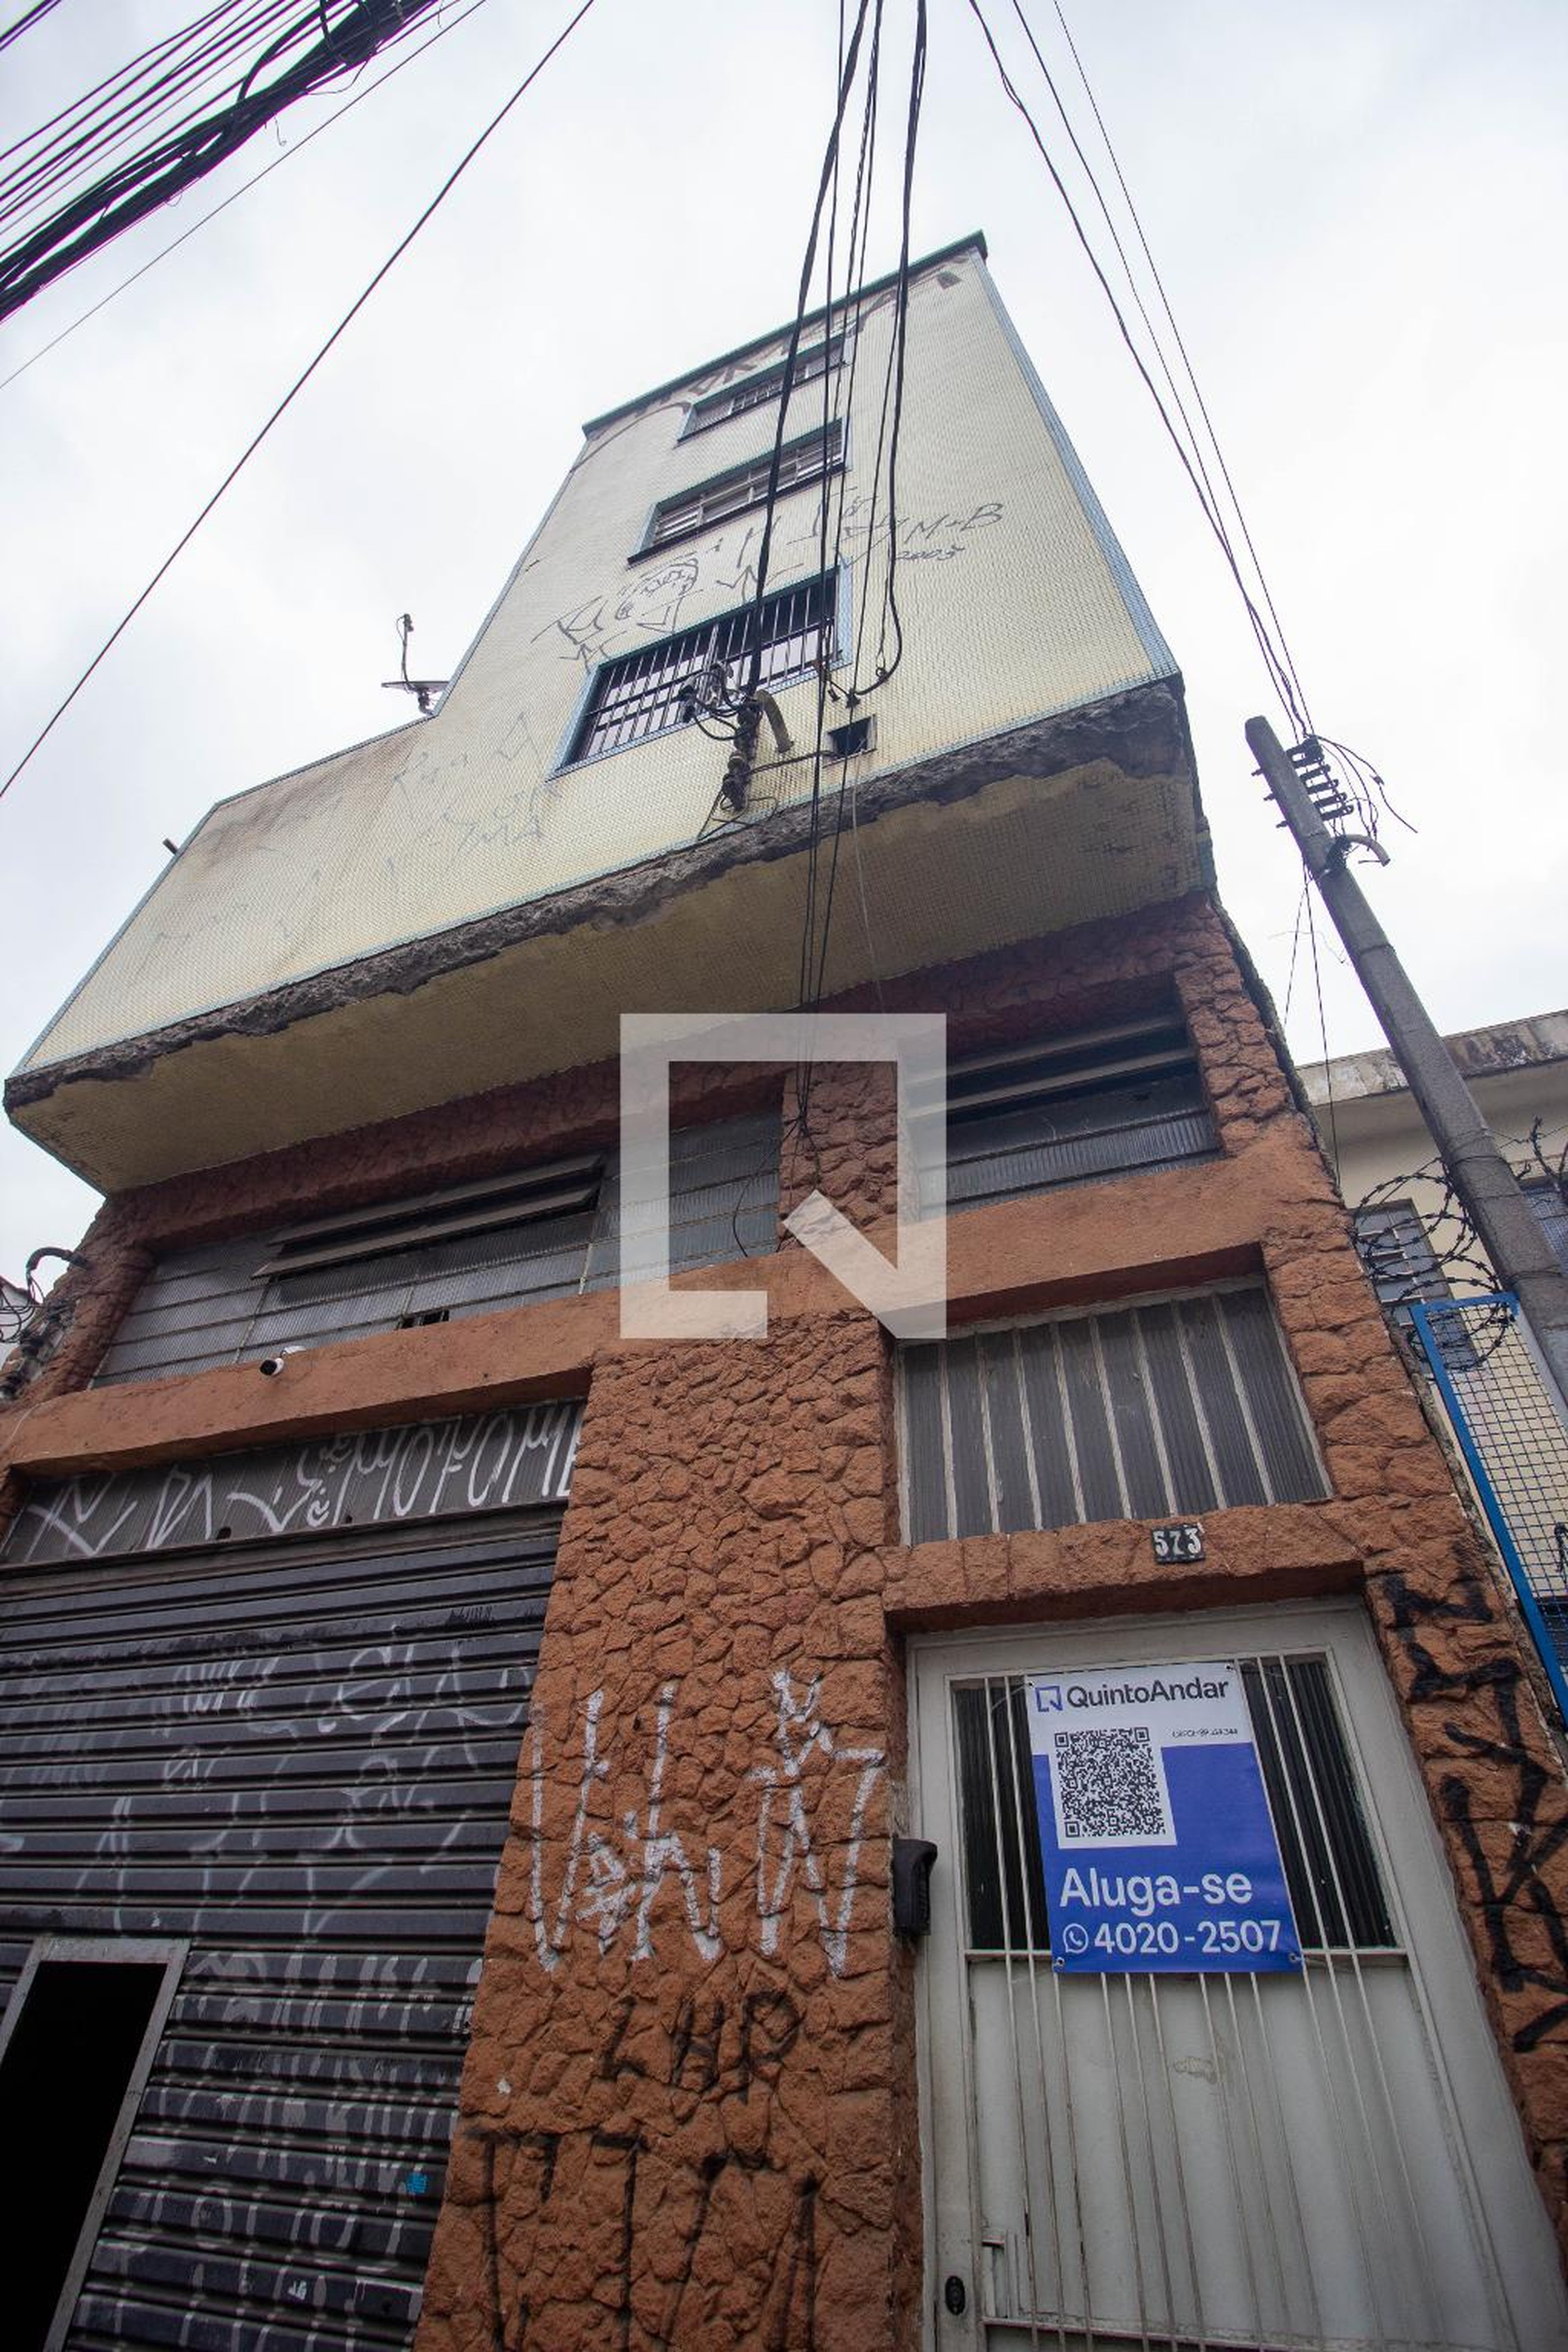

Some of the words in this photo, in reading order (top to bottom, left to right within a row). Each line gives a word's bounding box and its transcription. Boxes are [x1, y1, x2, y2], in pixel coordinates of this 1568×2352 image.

[1067, 1677, 1229, 1708] QuintoAndar
[1059, 1867, 1253, 1916] Aluga-se
[1094, 1920, 1281, 1954] 4020-2507
